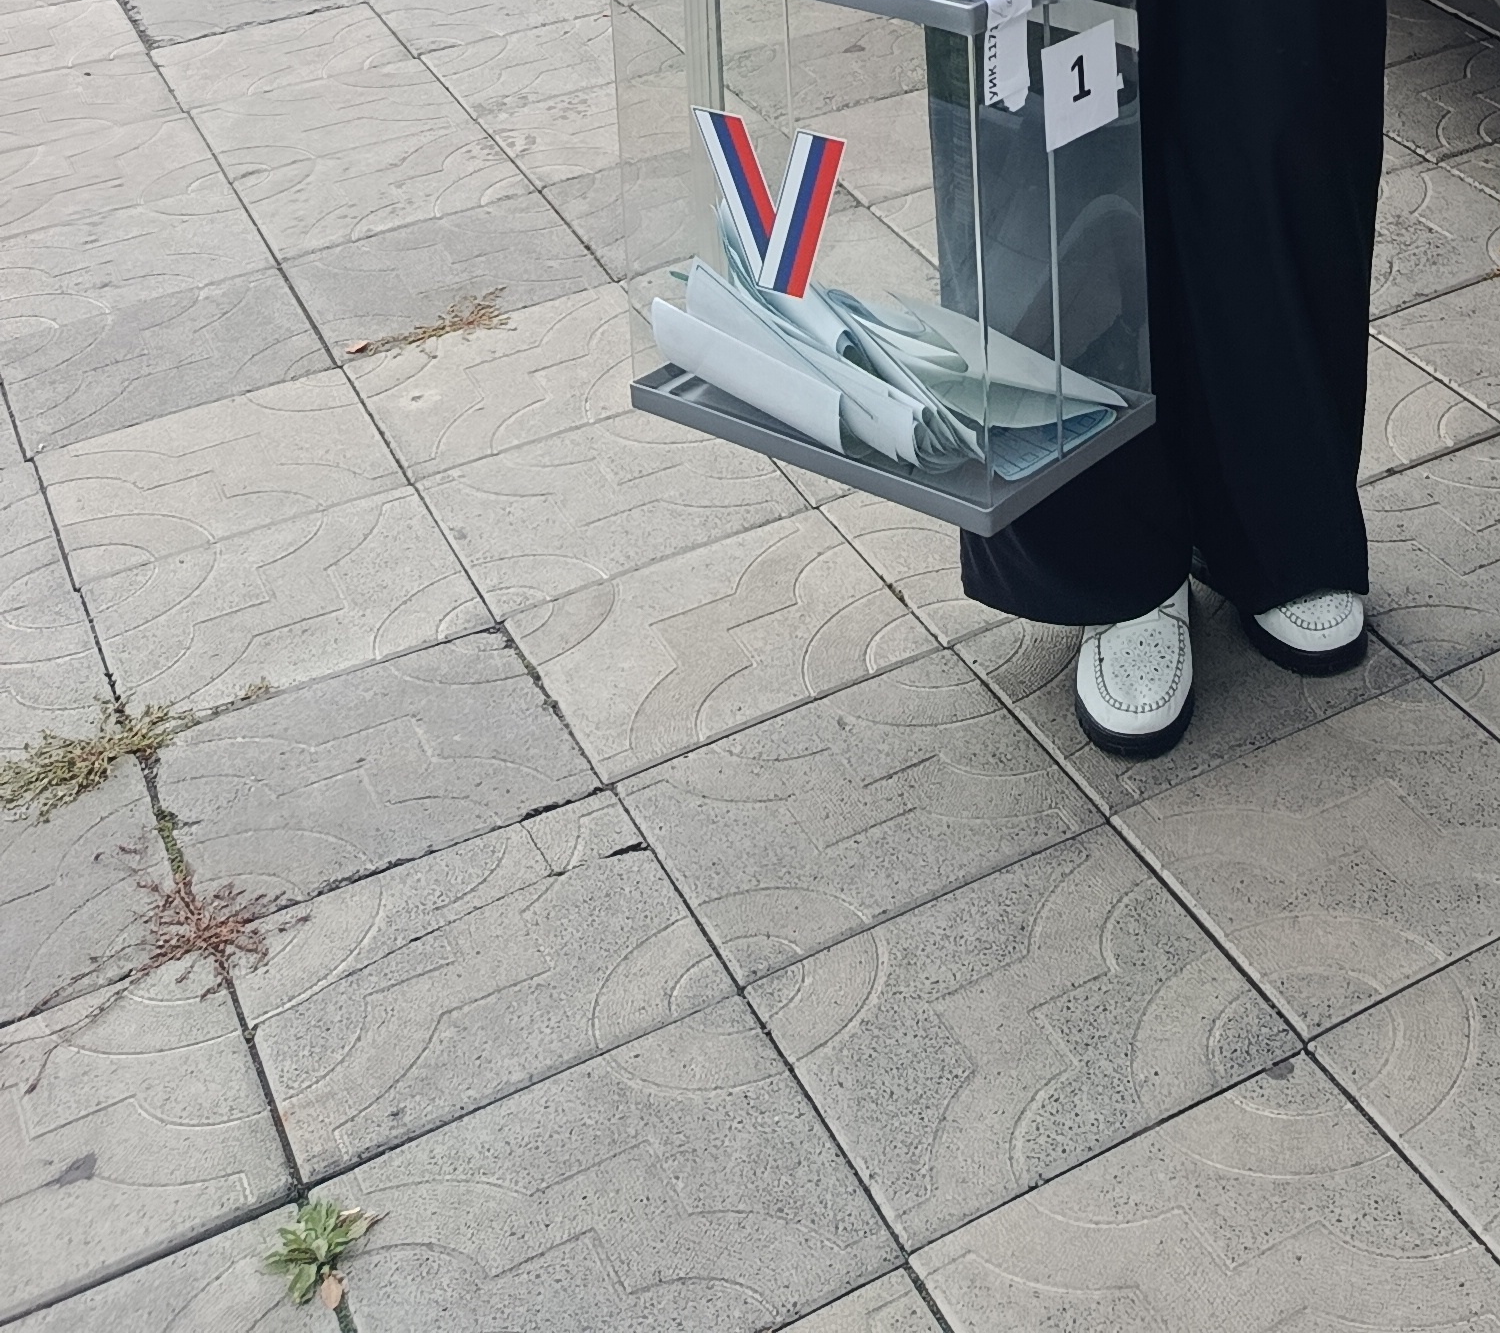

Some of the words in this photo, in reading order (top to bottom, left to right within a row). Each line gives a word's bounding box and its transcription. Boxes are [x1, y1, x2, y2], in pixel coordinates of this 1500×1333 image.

[988, 64, 999, 101] УИК
[1070, 54, 1091, 102] 1
[691, 105, 847, 299] V
